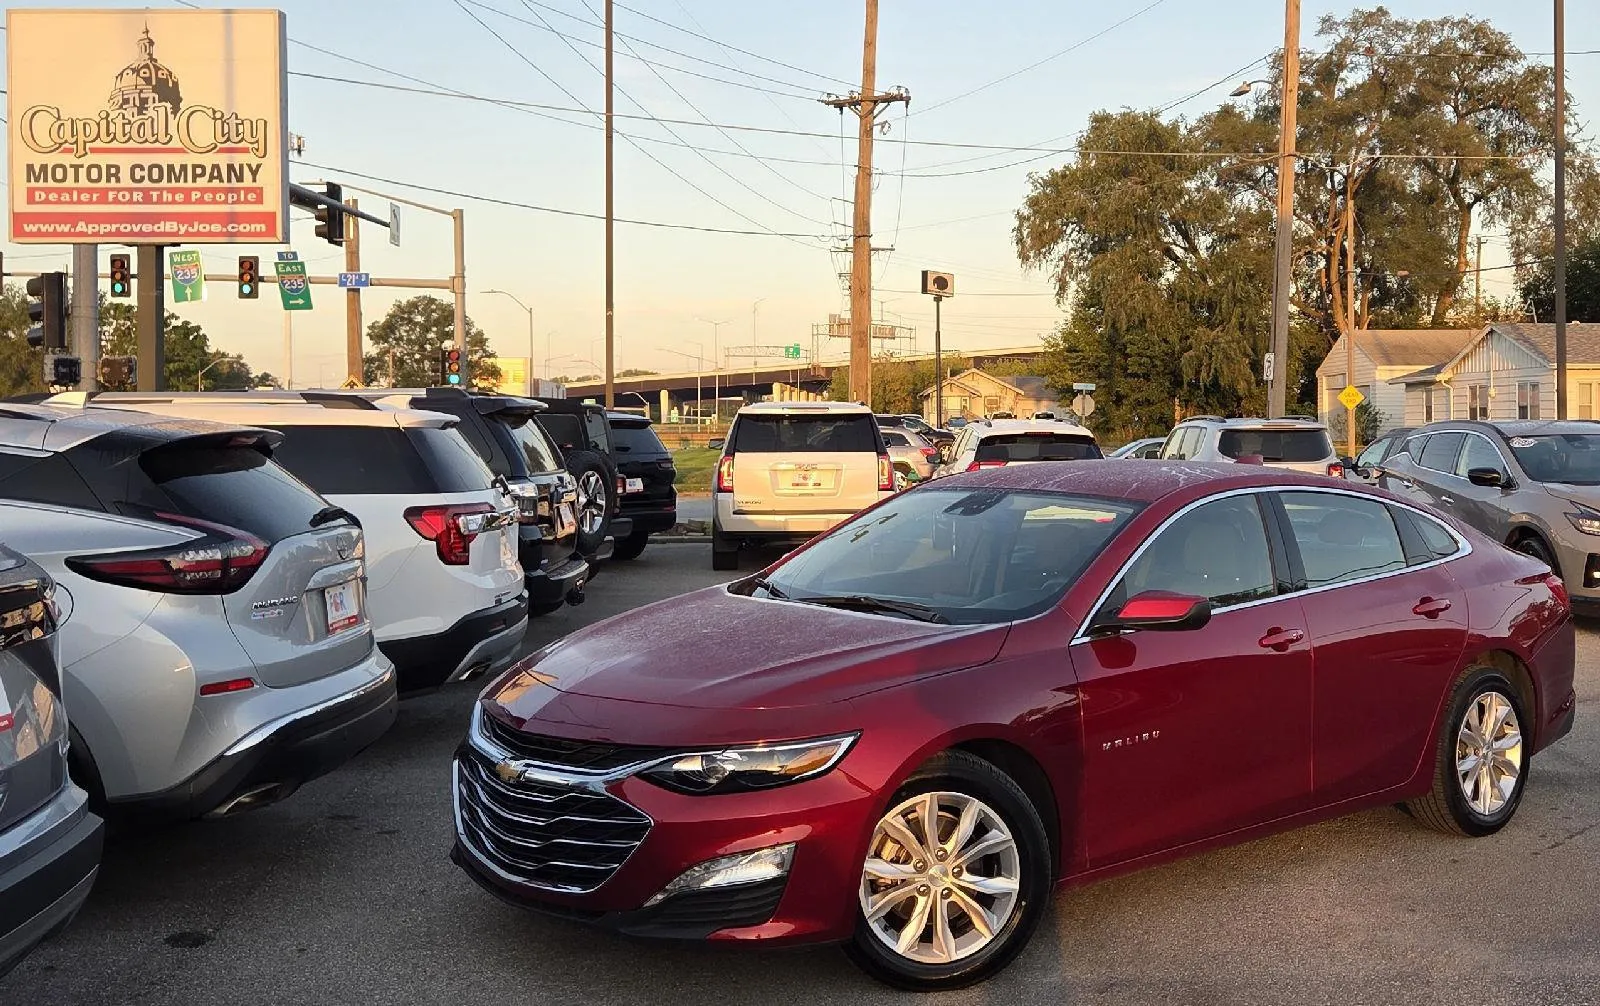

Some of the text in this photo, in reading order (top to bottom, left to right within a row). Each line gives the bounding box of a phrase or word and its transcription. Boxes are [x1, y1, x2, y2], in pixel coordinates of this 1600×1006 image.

[20, 105, 268, 158] Capital City
[26, 163, 263, 184] MOTOR COMPANY
[34, 190, 258, 205] Dealer FOR The People
[23, 221, 267, 235] www.ApprovedByJoe.com
[173, 253, 199, 262] WEST
[283, 252, 294, 260] TO
[279, 263, 302, 273] EAST
[176, 269, 198, 280] 235
[283, 280, 305, 290] 235
[1102, 730, 1160, 751] MALIBU
